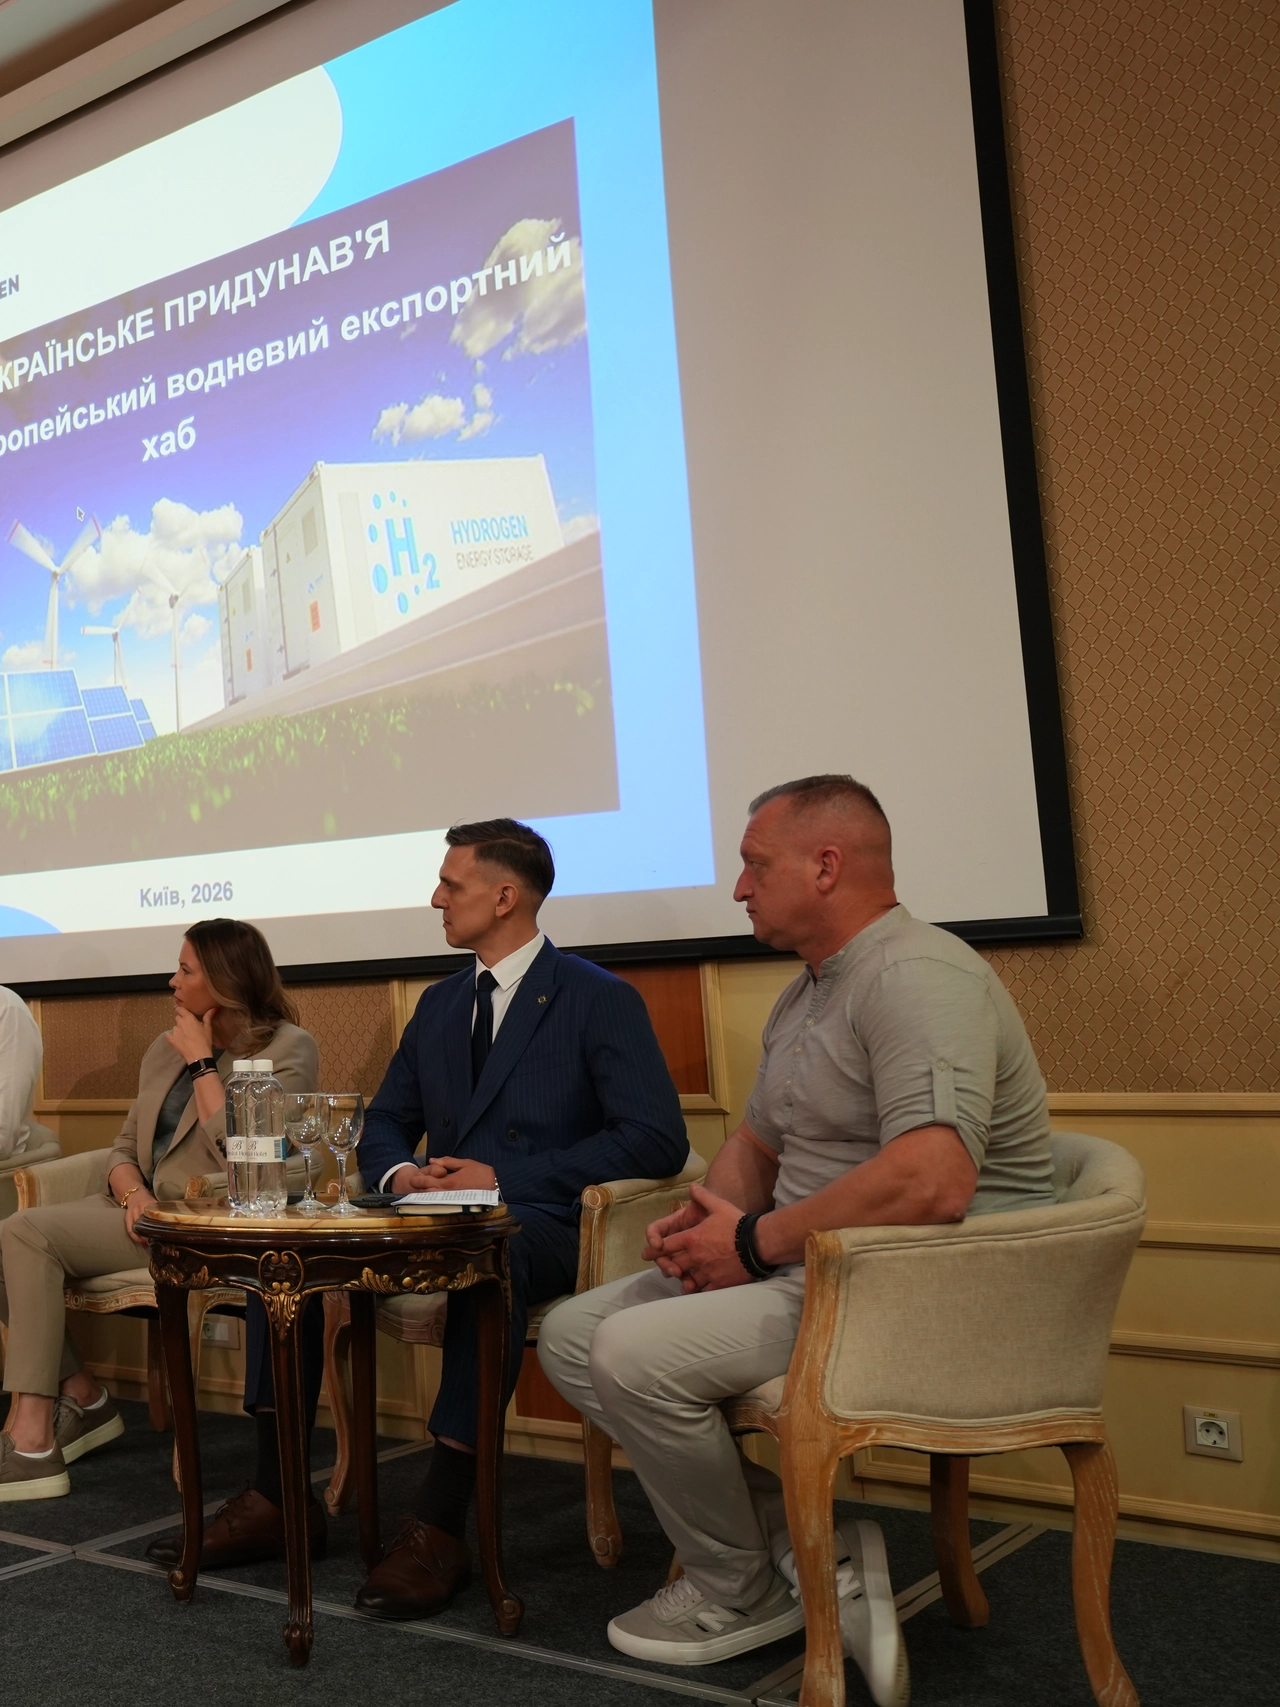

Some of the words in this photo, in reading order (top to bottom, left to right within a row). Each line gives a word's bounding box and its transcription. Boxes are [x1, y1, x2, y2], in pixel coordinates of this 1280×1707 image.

[164, 220, 390, 332] ПРИДУНАВ'Я
[166, 317, 329, 399] водневий
[340, 232, 572, 342] експортний
[141, 416, 197, 462] хаб
[450, 515, 529, 545] HYDROGEN
[456, 549, 494, 570] ENERGY
[140, 886, 185, 908] Київ,
[191, 881, 233, 903] 2026
